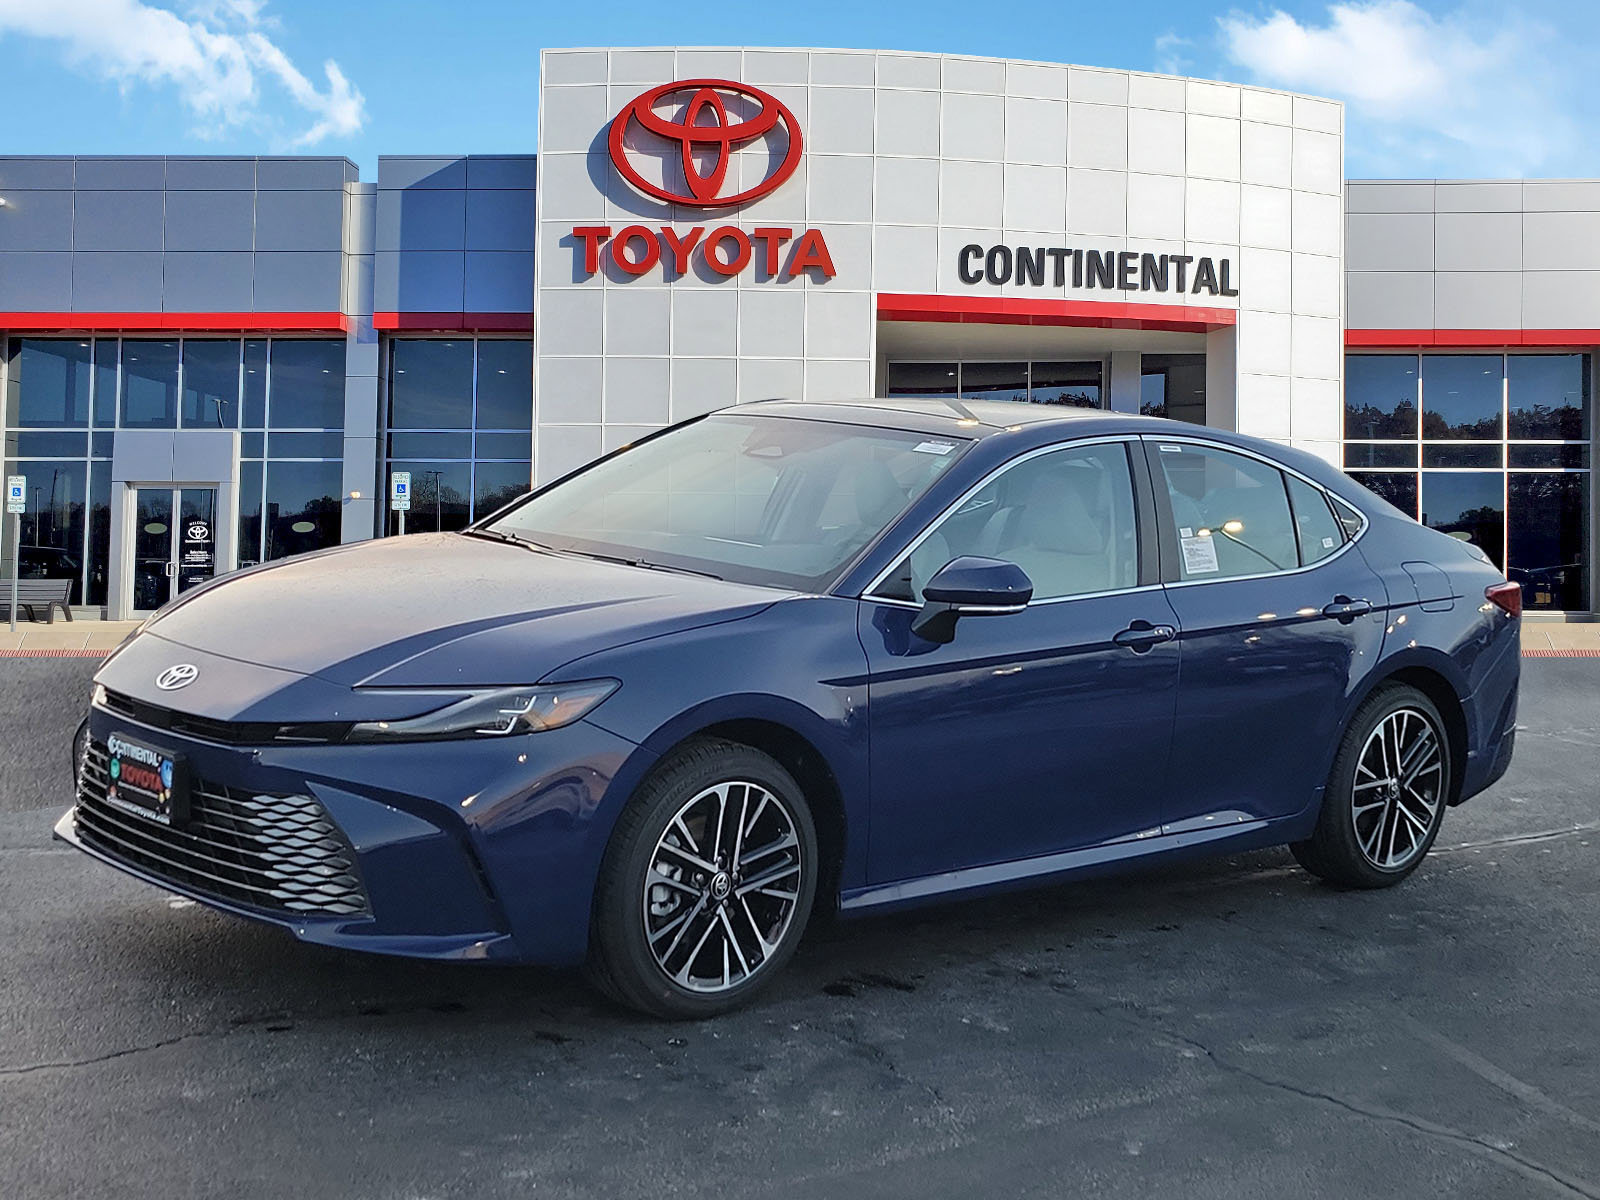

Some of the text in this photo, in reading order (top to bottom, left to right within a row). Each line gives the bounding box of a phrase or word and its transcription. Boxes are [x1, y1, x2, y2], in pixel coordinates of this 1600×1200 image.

[572, 225, 836, 276] TOYOTA
[958, 244, 1239, 297] CONTINENTAL
[121, 763, 164, 792] TOYOTA
